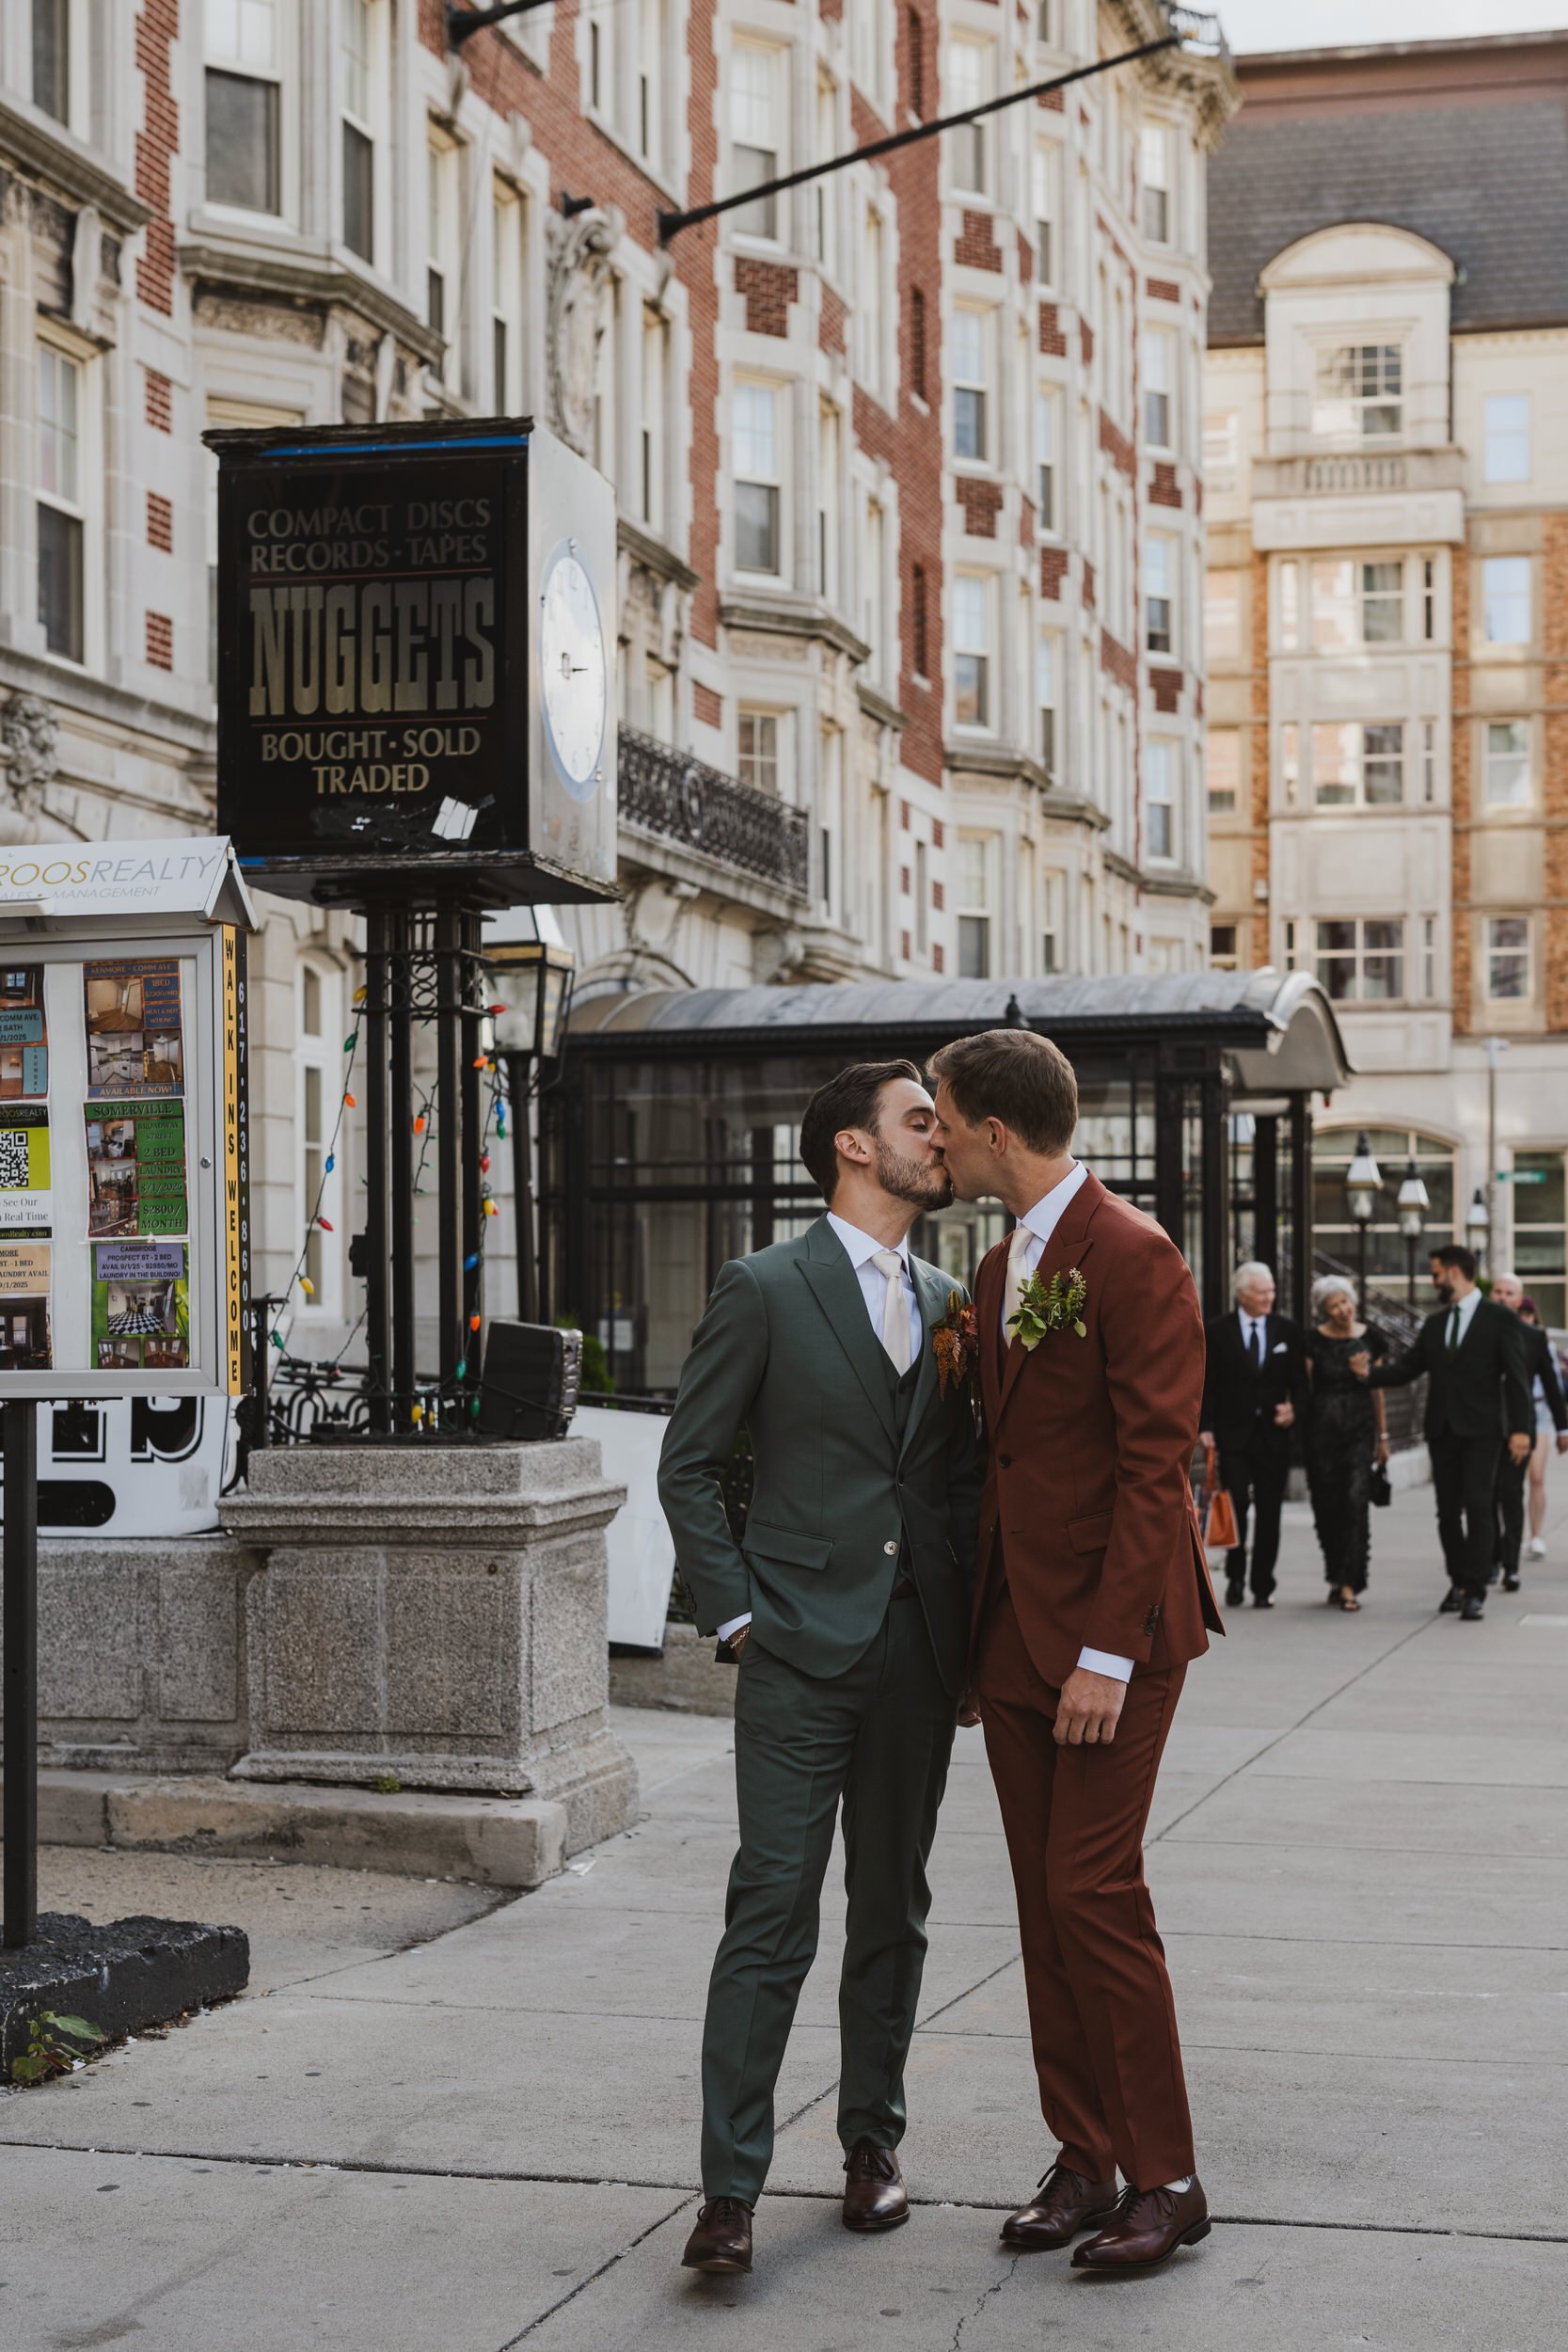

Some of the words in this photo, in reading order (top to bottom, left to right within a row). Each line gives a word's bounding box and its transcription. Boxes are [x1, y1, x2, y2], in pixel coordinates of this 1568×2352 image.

[247, 504, 392, 539] COMPACT
[407, 499, 491, 530] DISCS
[251, 539, 390, 573] RECORDS
[405, 533, 487, 564] TAPES
[248, 576, 495, 717] NUGGETS
[262, 730, 387, 762] BOUGHT
[403, 726, 481, 757] SOLD
[311, 764, 430, 794] TRADED
[52, 886, 161, 899] MANAGEMENT
[225, 939, 234, 1051] WALK
[100, 1087, 146, 1096] AVAILABLE
[94, 1103, 173, 1117] SOMERVILLE
[227, 1073, 235, 1155] INS
[144, 1148, 151, 1158] 2
[153, 1147, 176, 1158] BED
[139, 1166, 183, 1175] LAUNDRY
[3, 1198, 18, 1207] See
[20, 1197, 38, 1206] Our
[4, 1212, 23, 1221] Real
[25, 1211, 49, 1221] Time
[141, 1218, 183, 1230] MONTH
[228, 1180, 238, 1382] WELCOME
